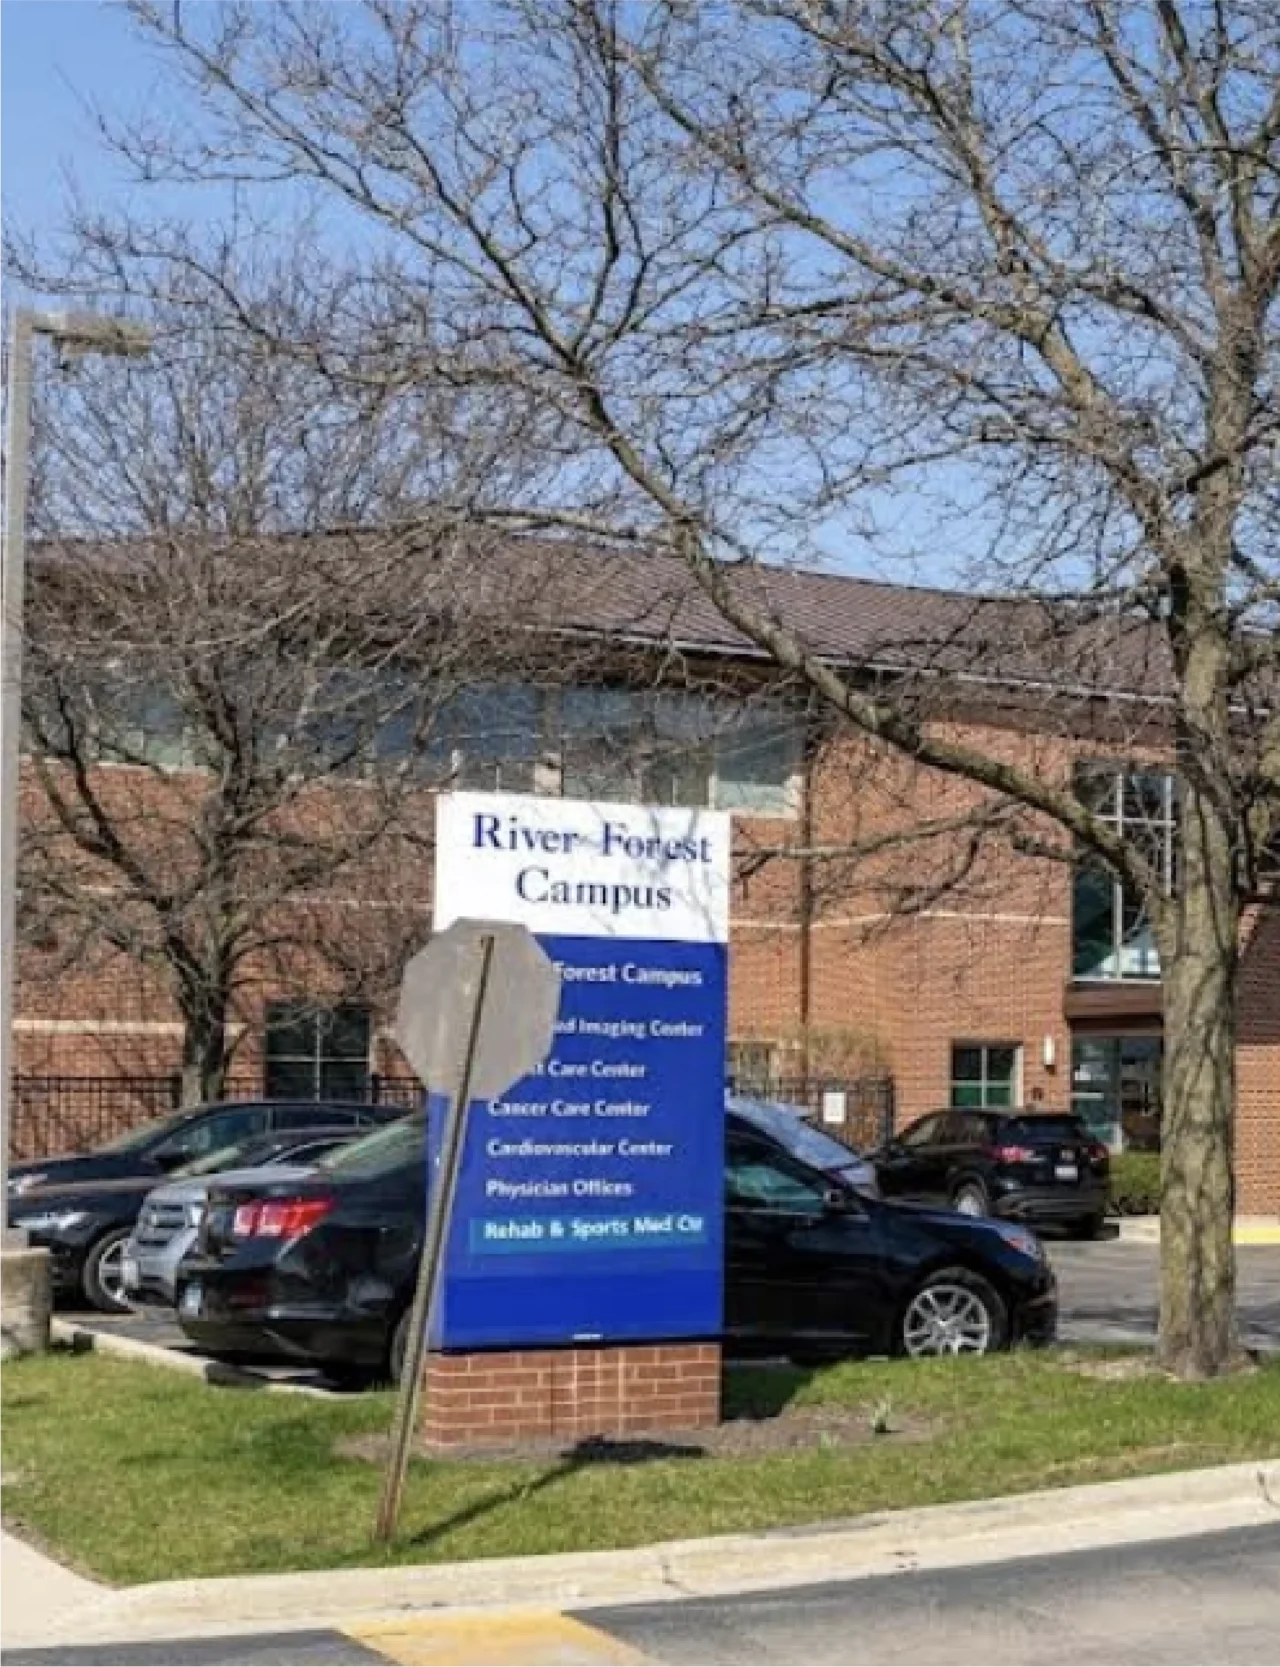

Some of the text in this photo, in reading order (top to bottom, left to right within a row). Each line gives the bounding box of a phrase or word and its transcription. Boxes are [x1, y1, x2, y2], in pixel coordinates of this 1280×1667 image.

[471, 811, 713, 863] River Forest
[516, 865, 672, 914] Campus
[622, 961, 703, 990] Campus
[551, 1017, 704, 1039] nd Imaging Center
[547, 1059, 588, 1078] Care
[591, 1060, 646, 1078] Center
[487, 1099, 650, 1117] Cancer Care Center
[486, 1138, 674, 1156] Cardiovascular Center
[485, 1178, 635, 1200] Physician Offices
[484, 1219, 545, 1240] Rehab
[549, 1219, 565, 1239] &
[569, 1216, 630, 1241] Sports
[632, 1214, 674, 1234] Med
